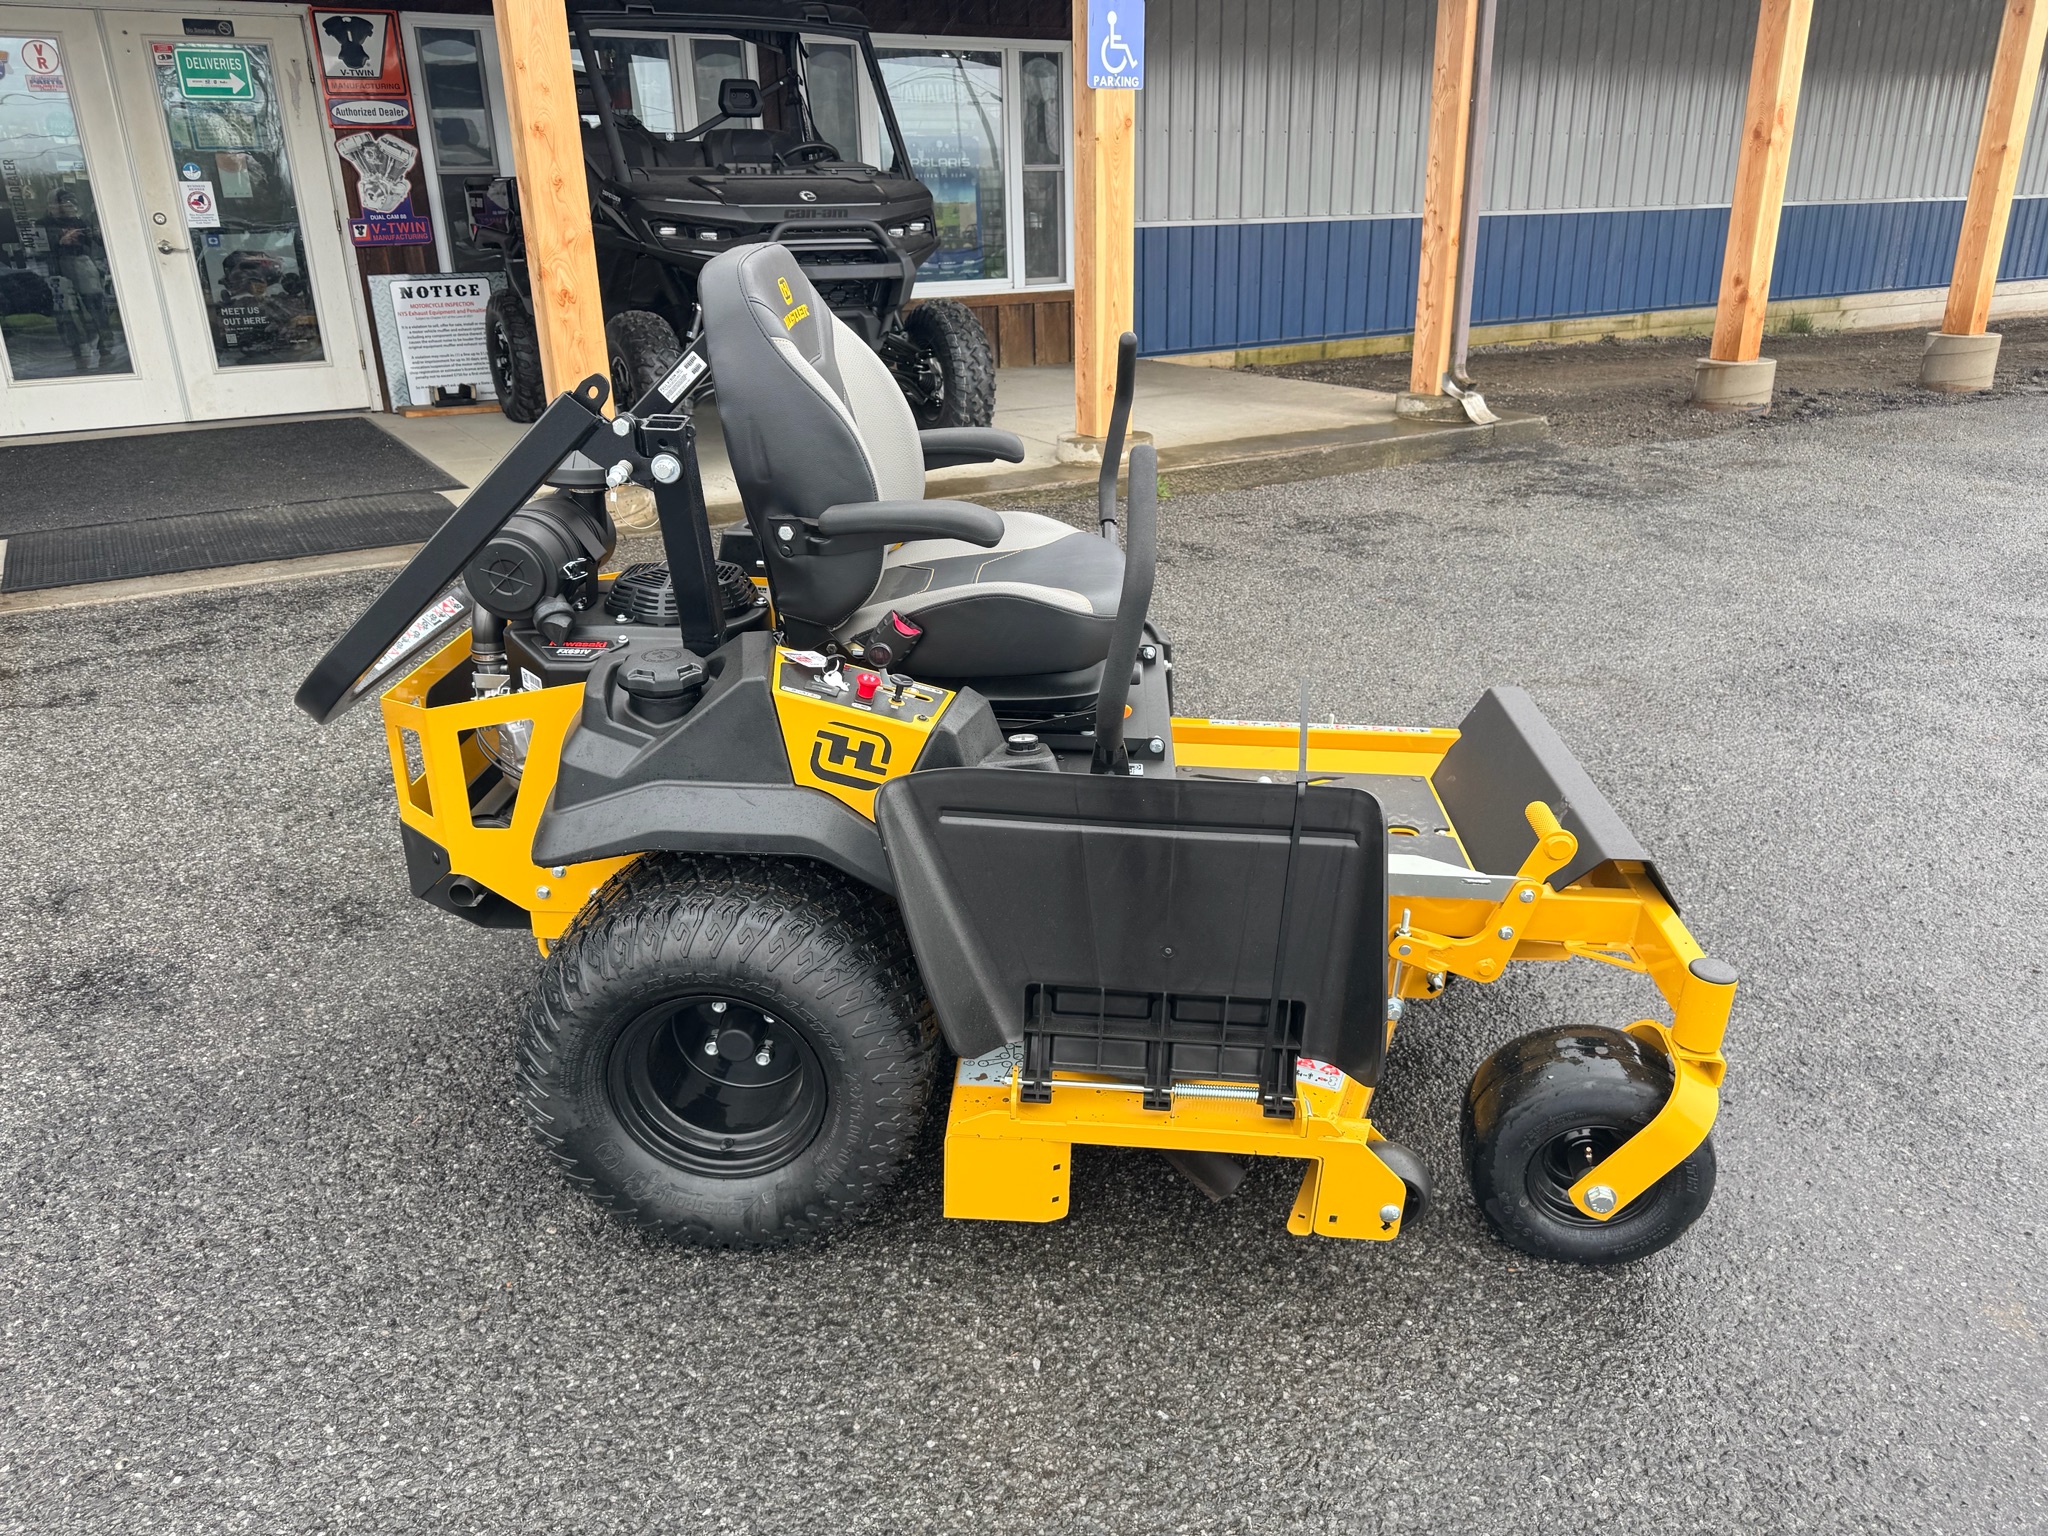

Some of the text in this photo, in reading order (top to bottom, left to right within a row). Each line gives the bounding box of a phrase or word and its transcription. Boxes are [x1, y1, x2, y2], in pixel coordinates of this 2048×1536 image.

[34, 44, 42, 56] V
[37, 57, 49, 69] R
[185, 57, 242, 70] DELIVERIES
[1094, 76, 1139, 87] PARKING
[336, 107, 404, 116] Authorized Dealer
[912, 158, 970, 168] POLARIS
[3, 160, 20, 192] DEALER
[784, 208, 848, 218] can-am
[371, 222, 426, 234] V-TWIN
[399, 284, 480, 299] NOTICE
[223, 316, 270, 325] OUT HERE.
[630, 972, 846, 1062] LAWN MONSTER
